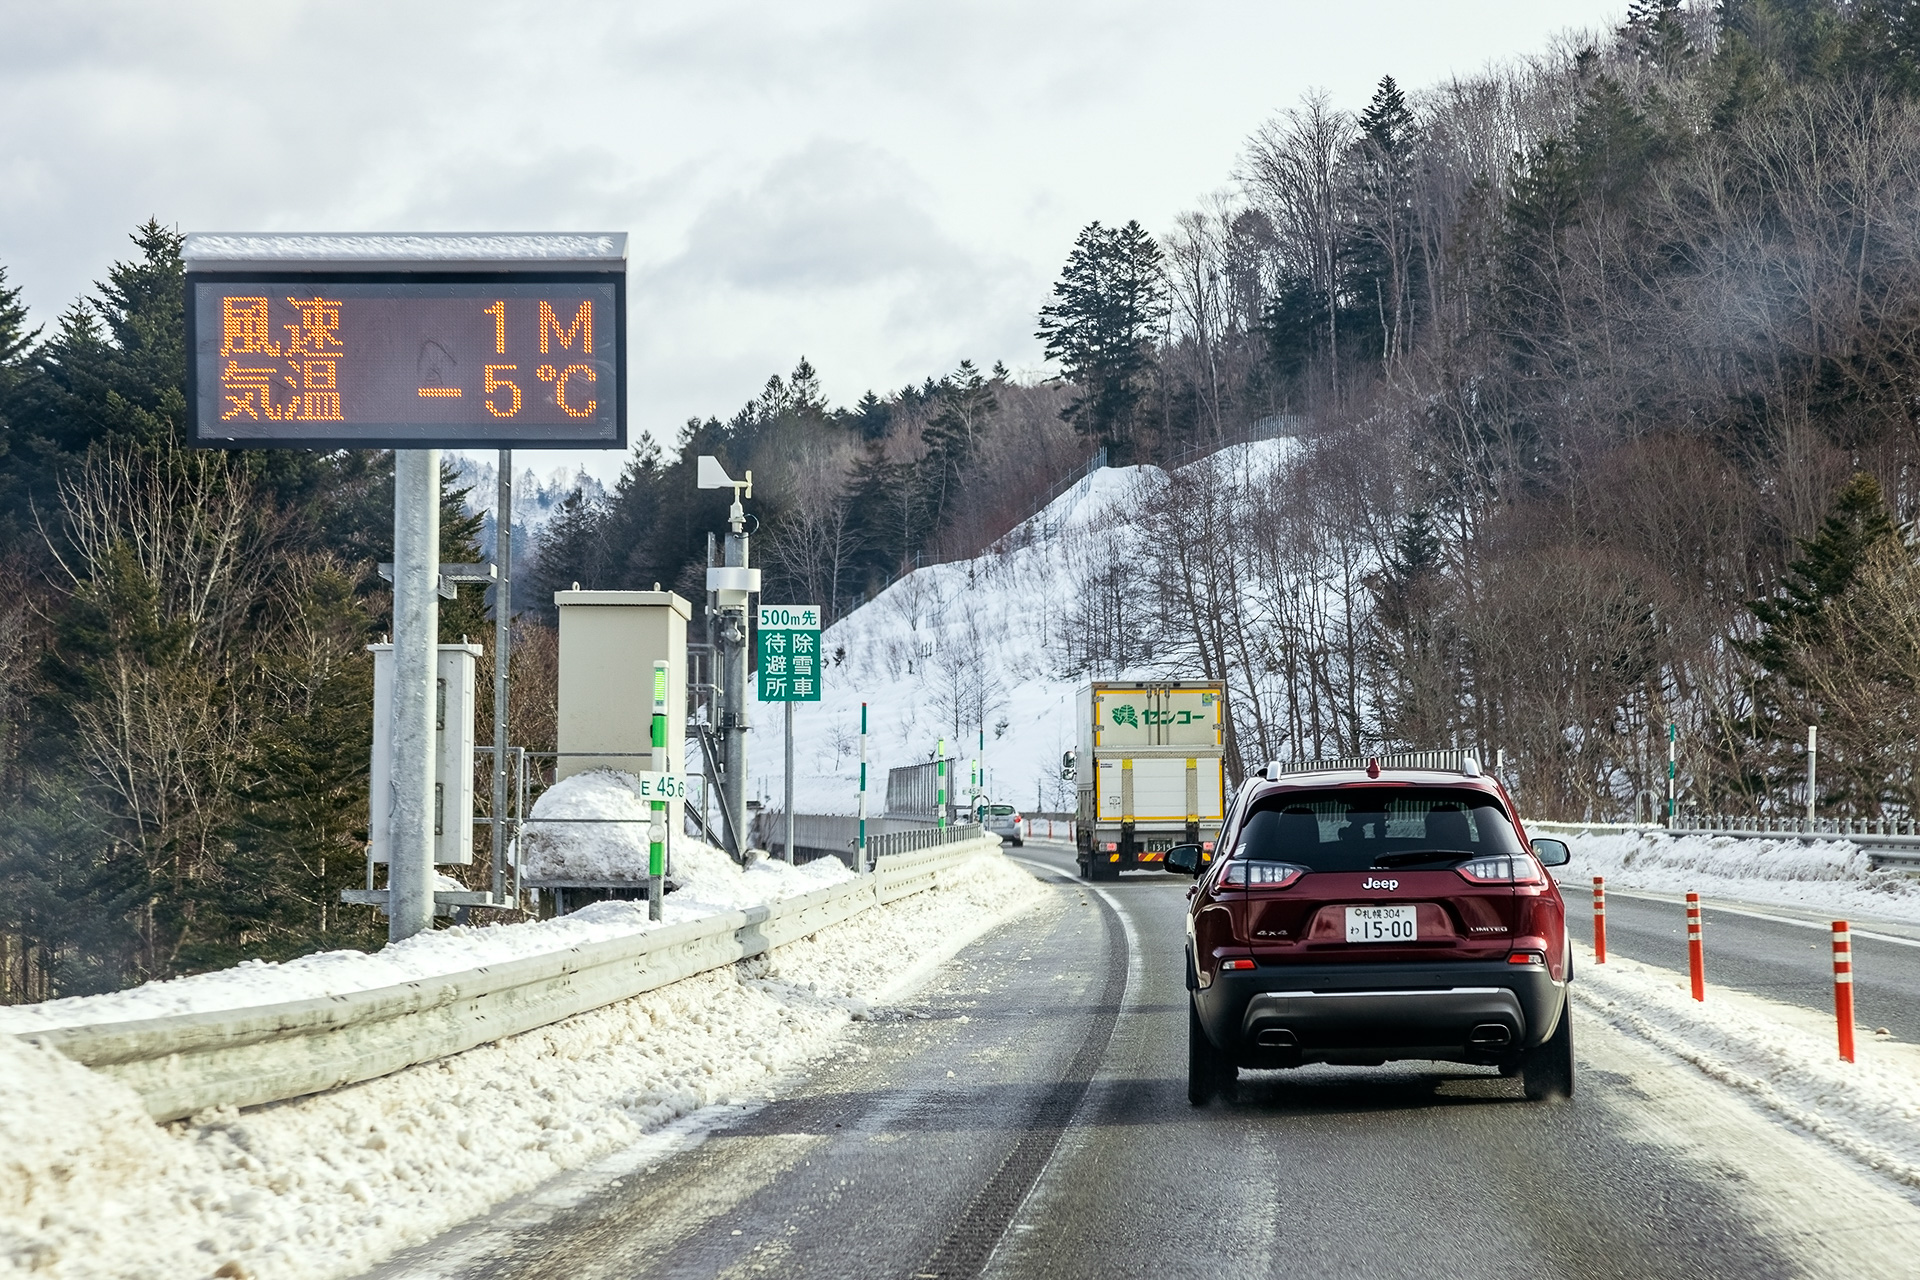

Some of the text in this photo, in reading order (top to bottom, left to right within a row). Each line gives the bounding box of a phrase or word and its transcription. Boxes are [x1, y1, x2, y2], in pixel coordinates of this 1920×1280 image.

[220, 296, 343, 357] 風速
[539, 300, 592, 354] M
[220, 360, 344, 420] 気温
[761, 609, 817, 626] 500m先
[765, 632, 787, 697] 待避所
[792, 632, 814, 697] 除雪車
[1141, 709, 1205, 725] センコー
[641, 776, 685, 798] E 45.6
[1362, 877, 1399, 891] Jeep
[1350, 920, 1412, 939] わ 15-00
